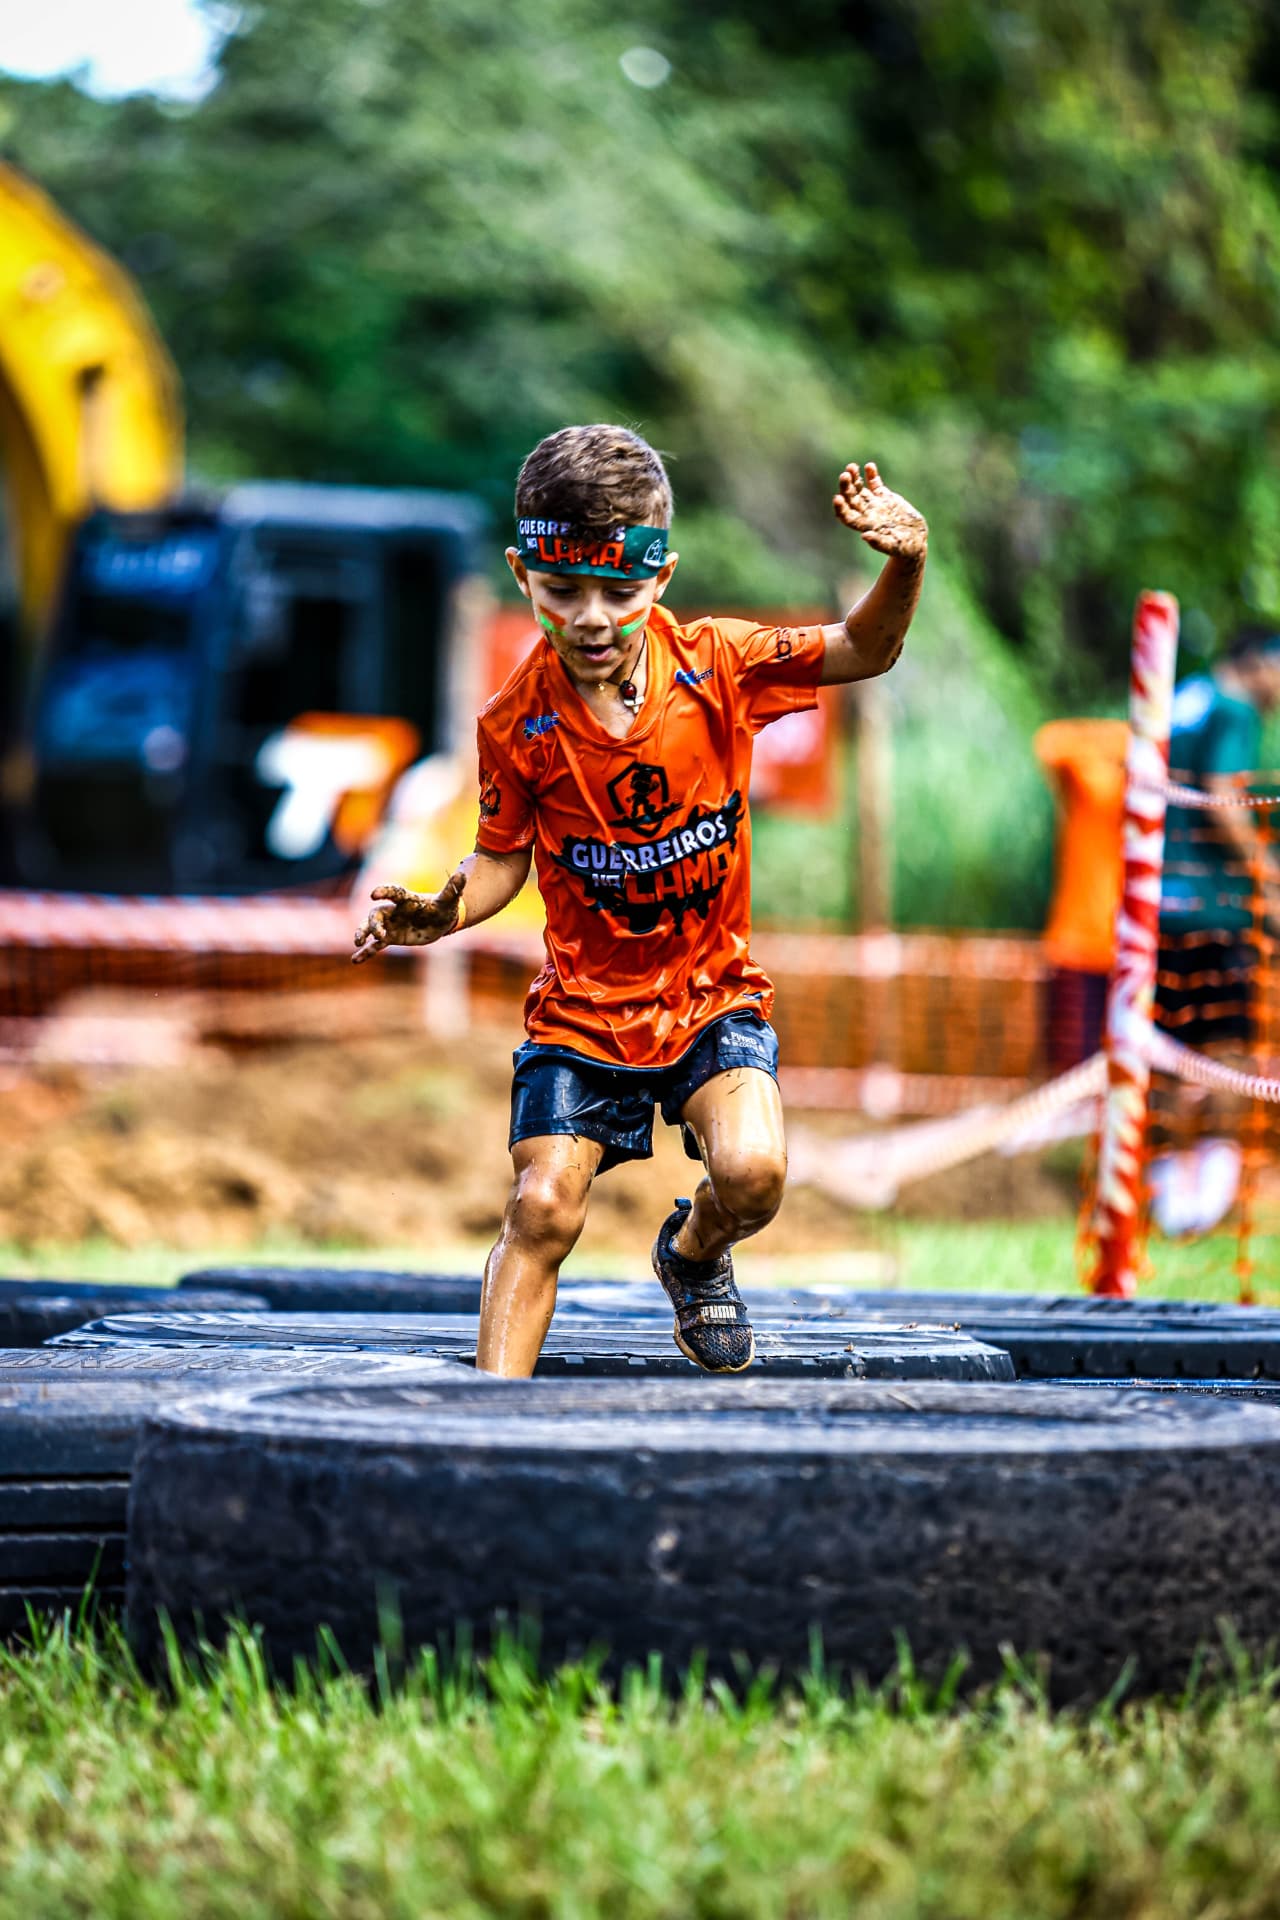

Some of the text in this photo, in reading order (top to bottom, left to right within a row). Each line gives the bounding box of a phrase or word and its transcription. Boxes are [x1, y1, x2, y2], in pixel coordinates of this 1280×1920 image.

[519, 519, 626, 542] GUERRES
[571, 814, 728, 872] GUERREIROS
[700, 1305, 737, 1319] PUMA
